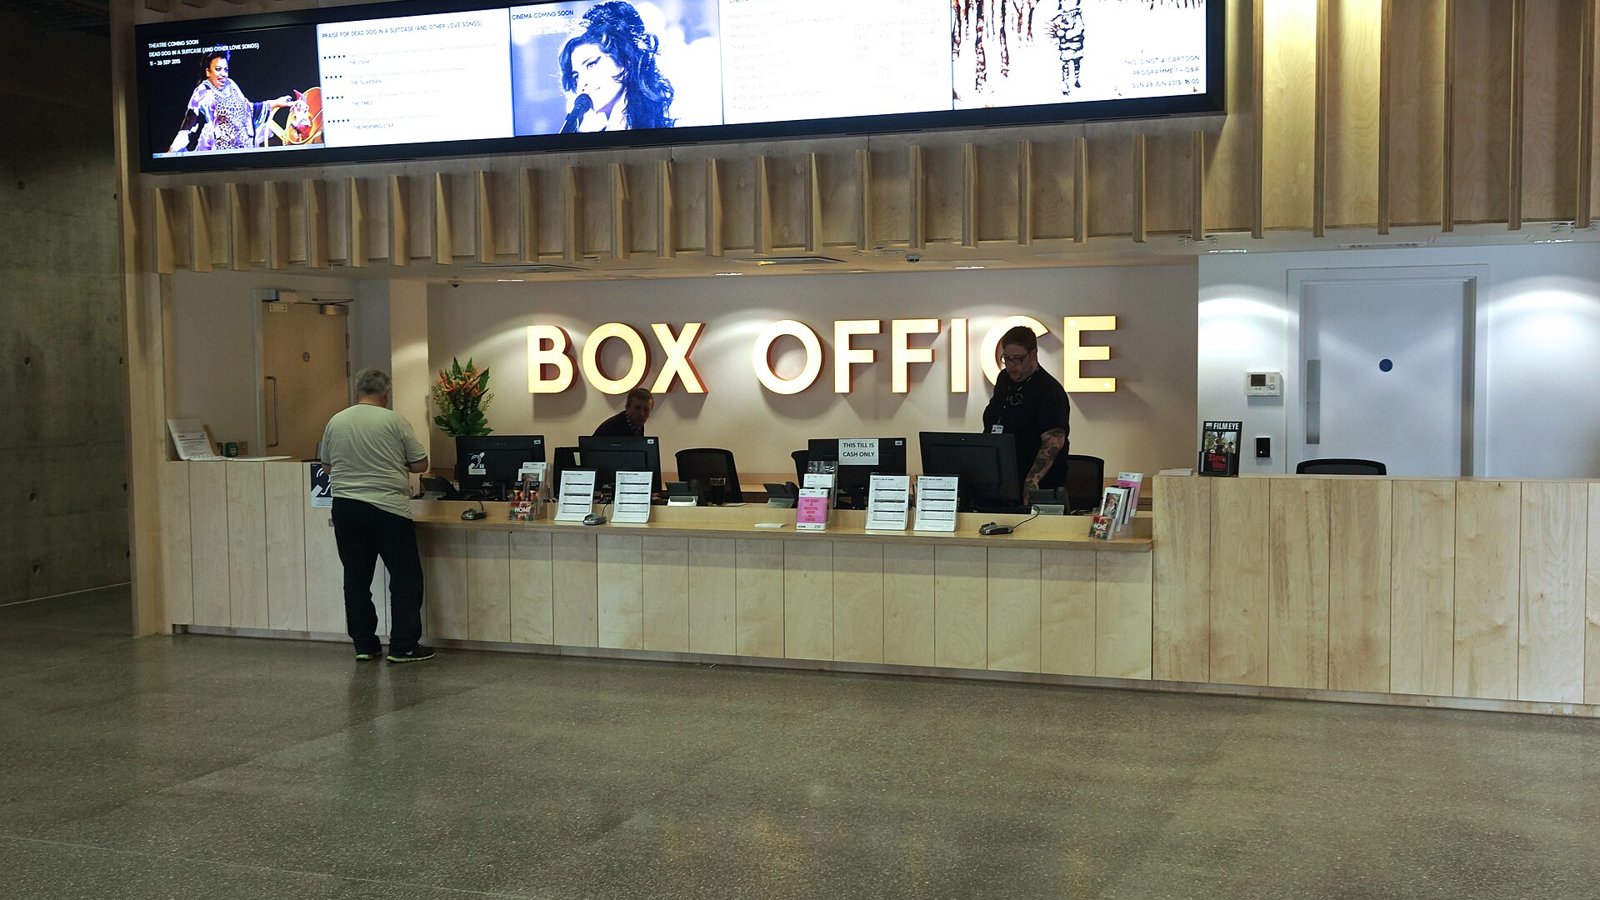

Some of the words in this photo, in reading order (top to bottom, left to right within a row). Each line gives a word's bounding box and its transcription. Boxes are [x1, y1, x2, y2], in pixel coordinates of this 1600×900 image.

[389, 25, 413, 33] SUITCASE
[447, 21, 460, 29] LOVE
[241, 42, 259, 50] SONGS)
[1167, 55, 1200, 63] CARTOON
[1132, 67, 1173, 75] PROGRAMME
[527, 321, 708, 394] BOX
[752, 315, 1117, 394] OFFICE
[1213, 422, 1228, 430] FILM
[1228, 422, 1239, 430] EYE
